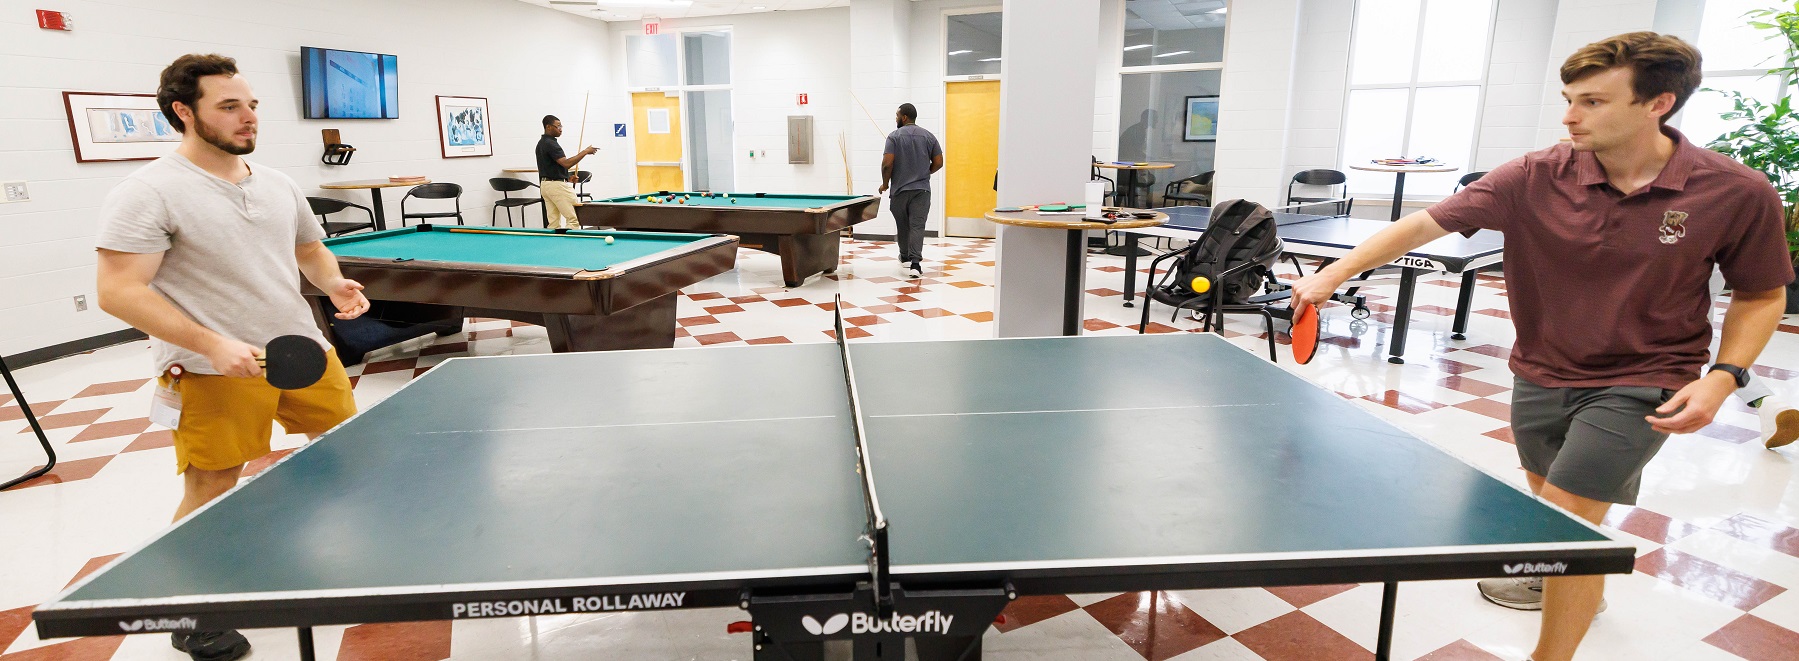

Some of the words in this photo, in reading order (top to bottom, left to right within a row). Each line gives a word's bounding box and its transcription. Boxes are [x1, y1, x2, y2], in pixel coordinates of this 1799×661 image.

[645, 23, 659, 35] EXIT
[1394, 256, 1434, 269] TIGA
[1523, 561, 1568, 574] Butterfly
[452, 598, 567, 618] PERSONAL
[572, 592, 686, 612] ROLLAWAY
[143, 617, 197, 631] Butterfly
